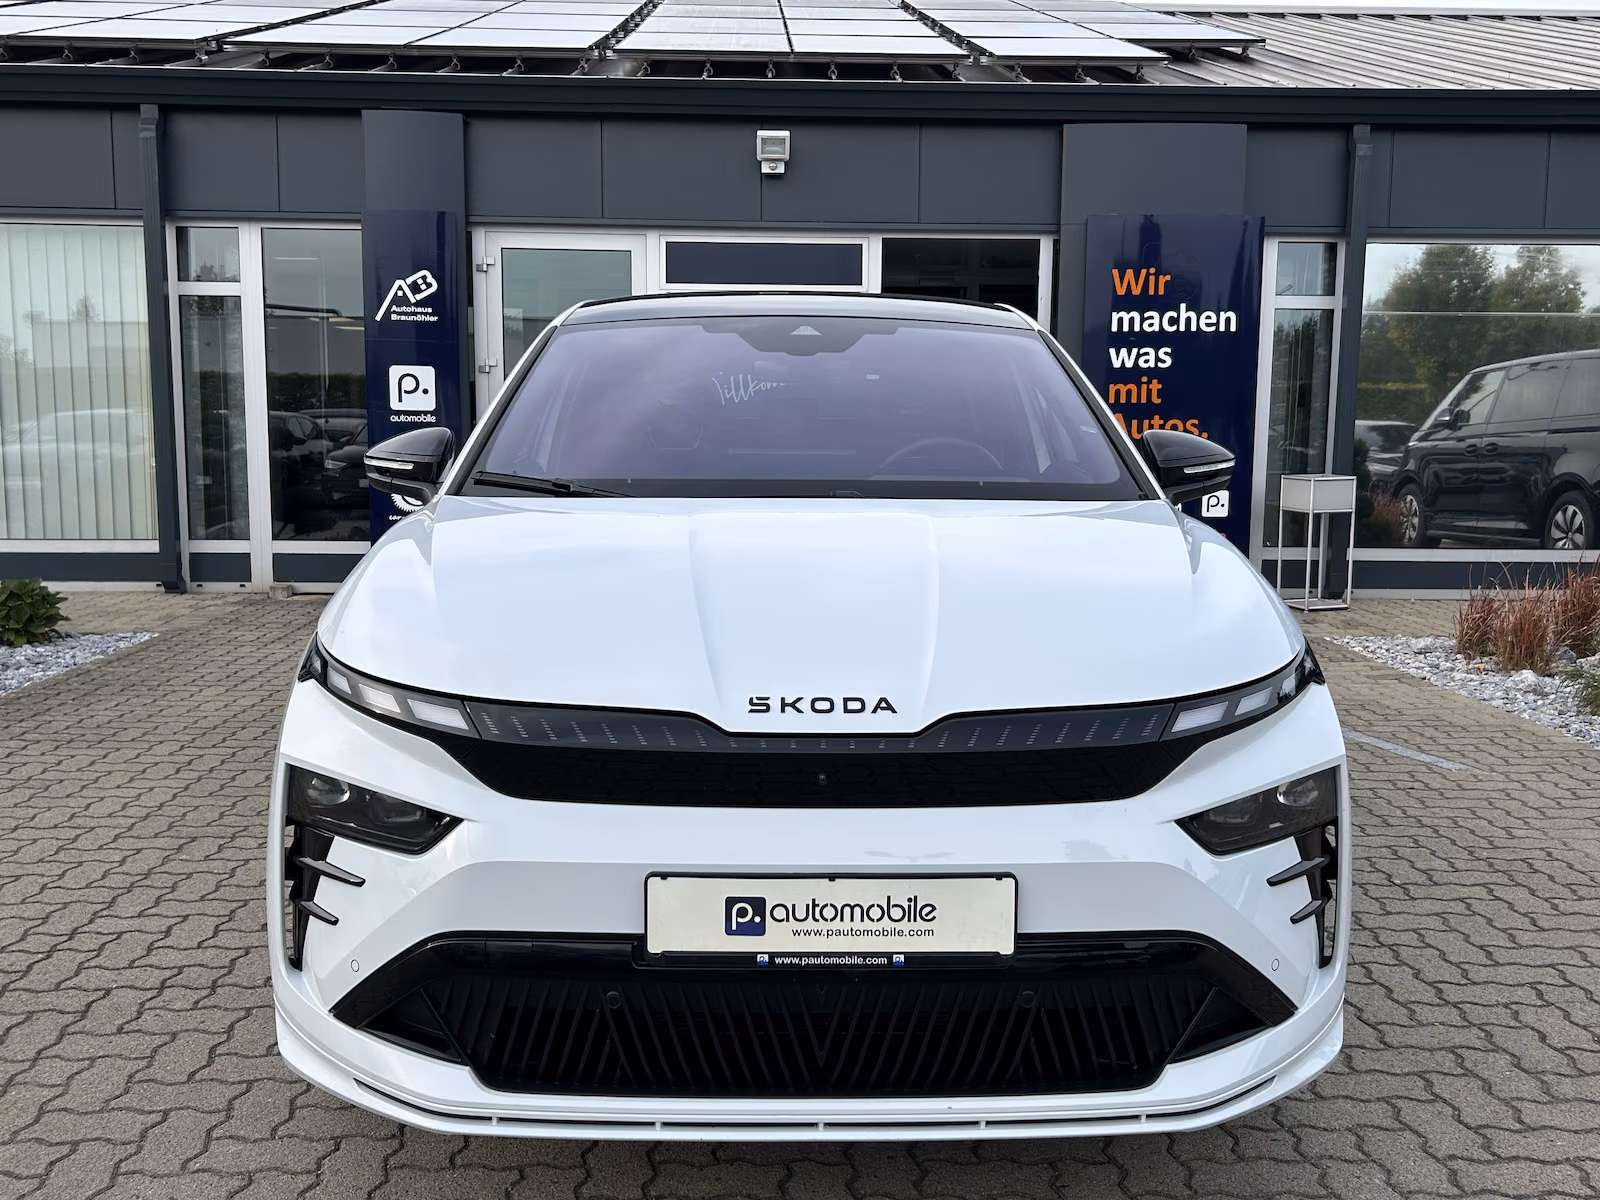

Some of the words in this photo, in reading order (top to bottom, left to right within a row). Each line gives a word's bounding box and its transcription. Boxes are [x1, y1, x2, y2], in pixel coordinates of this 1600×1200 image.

[1111, 267, 1171, 296] Wir
[390, 304, 433, 313] Autohaus
[390, 313, 439, 322] Braunöhler
[1111, 303, 1237, 332] machen
[1108, 347, 1172, 368] was
[1108, 376, 1163, 404] mit
[390, 413, 437, 423] automobile
[769, 895, 937, 923] automobile
[791, 926, 935, 939] www.pautomobile.com
[774, 955, 888, 966] www.pautomobile.com
